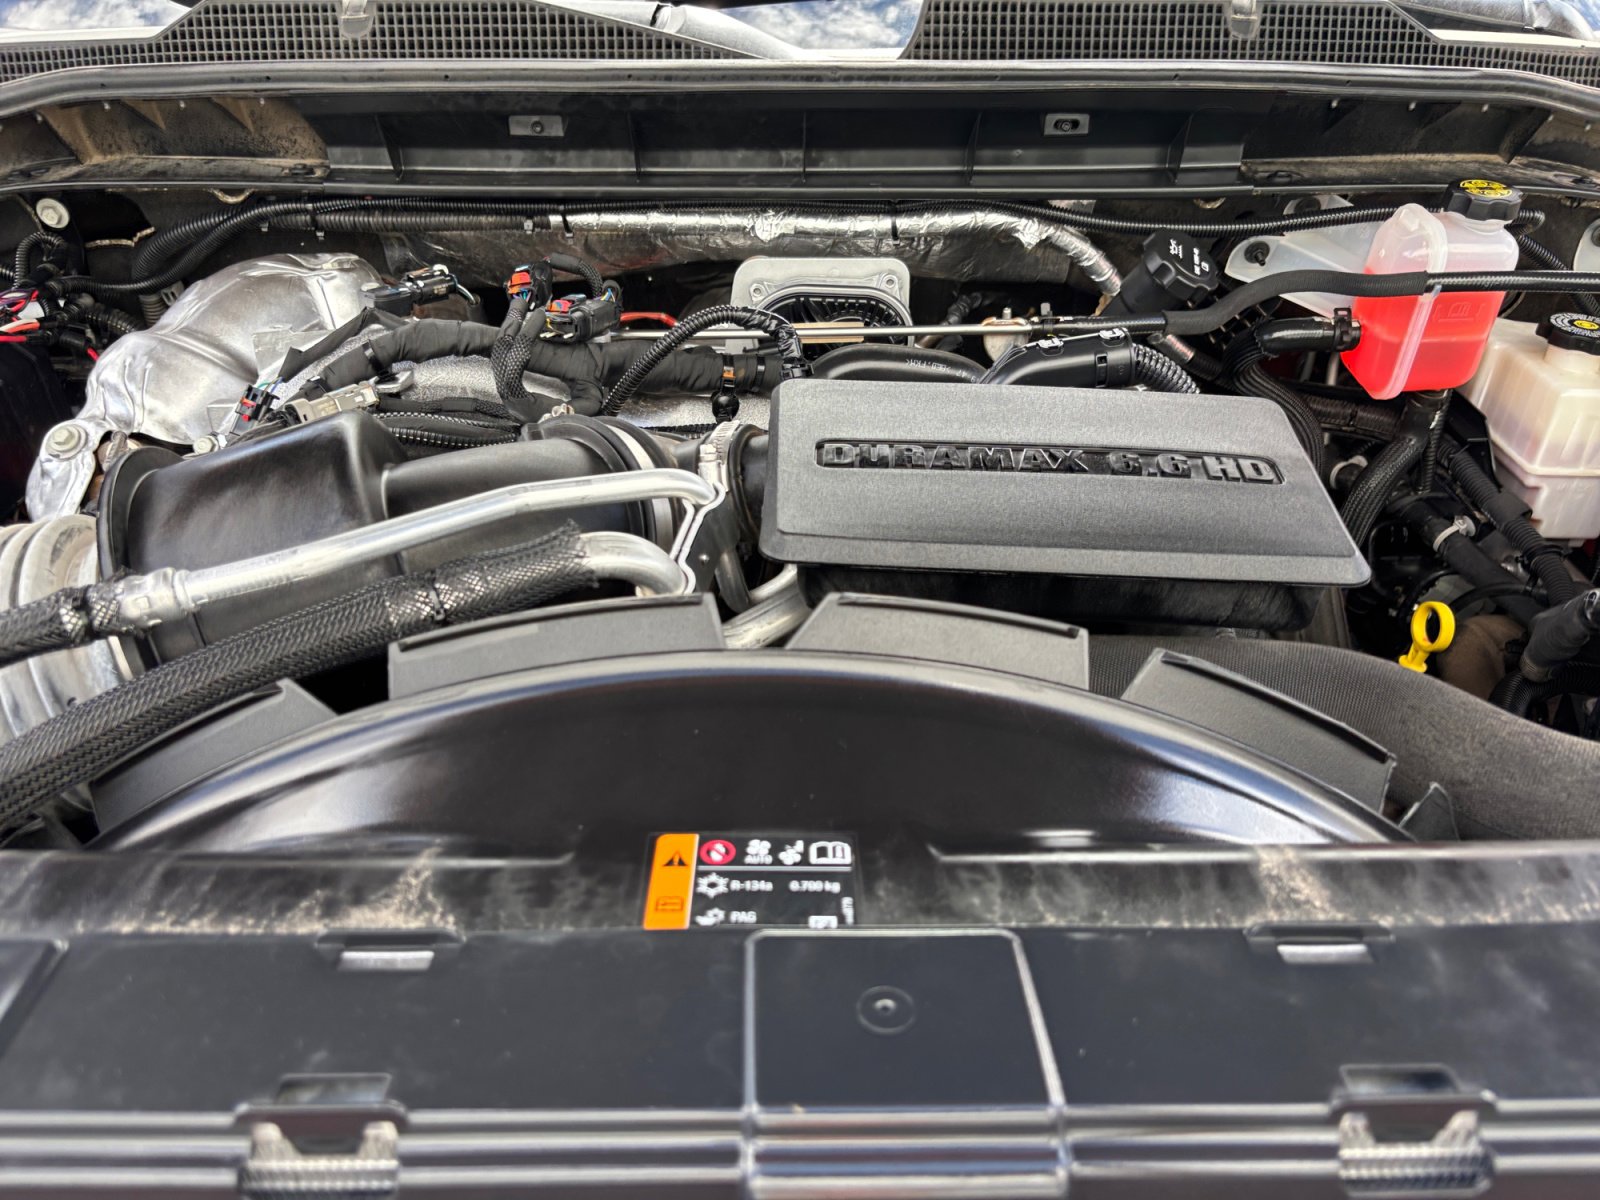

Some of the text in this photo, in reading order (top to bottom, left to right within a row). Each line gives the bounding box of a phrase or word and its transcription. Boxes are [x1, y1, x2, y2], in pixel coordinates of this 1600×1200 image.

[822, 442, 1279, 484] DURAMAX 6.6 HD
